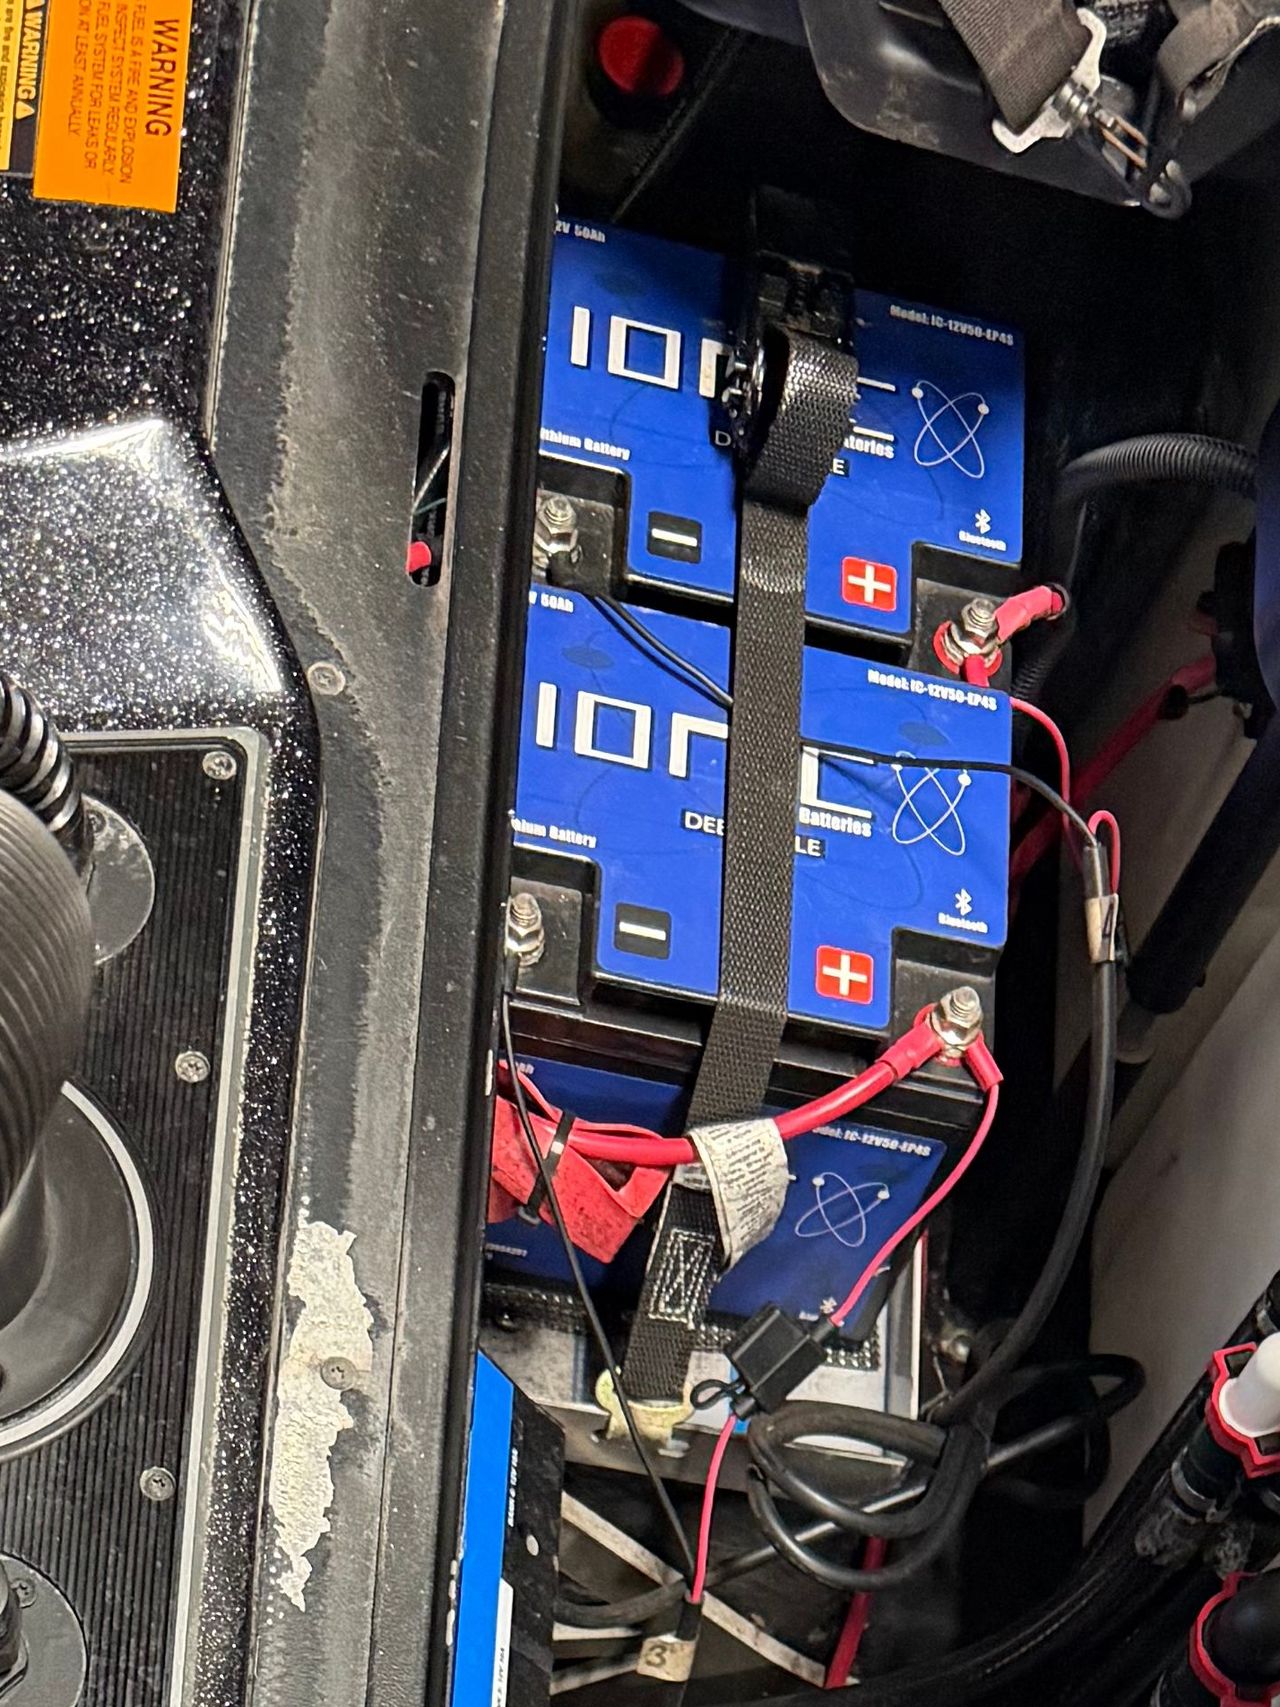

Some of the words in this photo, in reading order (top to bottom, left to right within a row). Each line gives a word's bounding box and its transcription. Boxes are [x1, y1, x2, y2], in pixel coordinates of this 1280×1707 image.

[76, 19, 89, 32] AT
[0, 44, 11, 62] and
[73, 35, 88, 71] LEAST
[129, 49, 141, 57] A
[130, 35, 143, 47] IS
[17, 12, 43, 99] WARNING
[91, 33, 107, 79] SYSTEM
[108, 55, 123, 101] SYSTEM
[127, 60, 141, 85] FIRE
[145, 18, 179, 136] WARNING
[89, 83, 103, 107] FOR
[124, 89, 138, 114] AND
[85, 110, 100, 147] LEAKS
[83, 151, 97, 169] OR
[118, 116, 136, 183] EXPLOSION
[554, 219, 571, 234] 2V
[582, 436, 631, 460] Battery
[539, 592, 575, 613] 50Ah
[865, 669, 911, 690] Model:
[908, 678, 999, 711] IC-12V50-EP4S
[797, 806, 874, 837] Batteries
[548, 825, 597, 848] Battery
